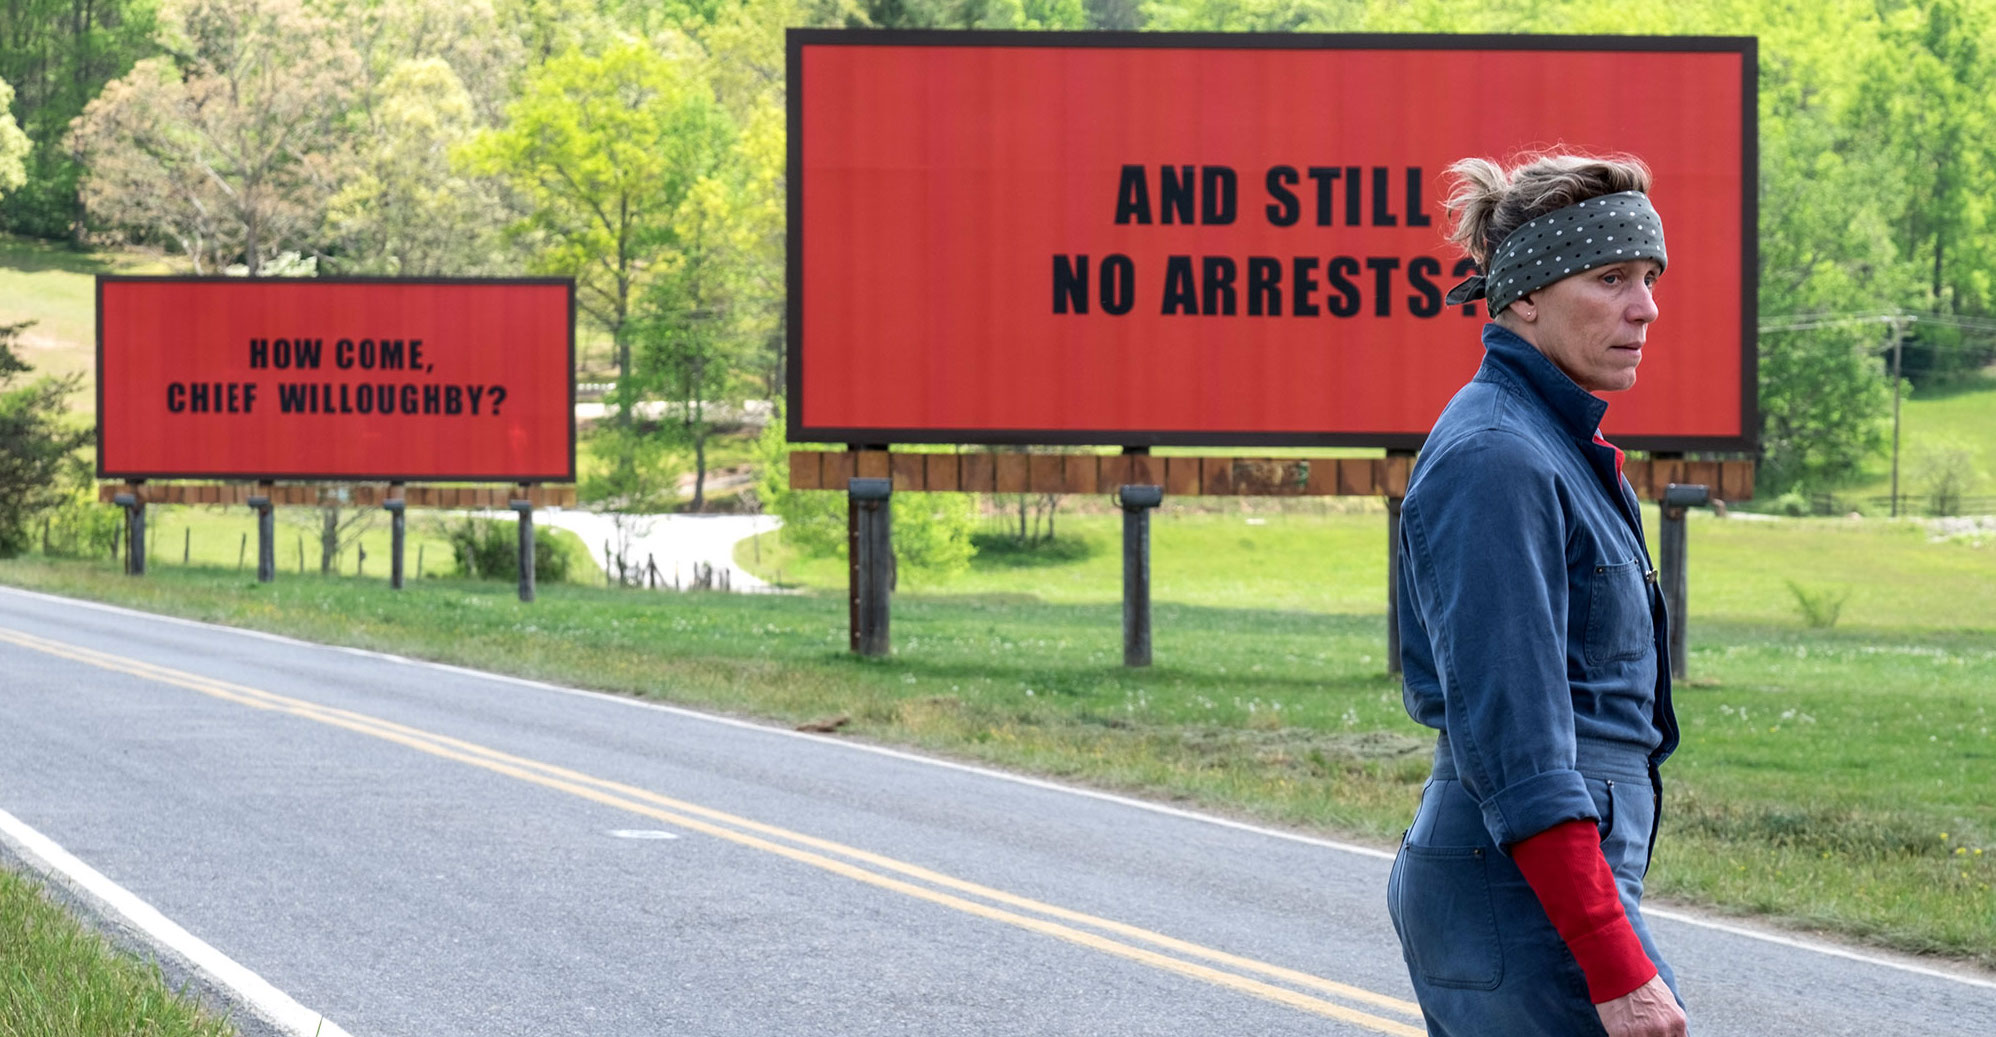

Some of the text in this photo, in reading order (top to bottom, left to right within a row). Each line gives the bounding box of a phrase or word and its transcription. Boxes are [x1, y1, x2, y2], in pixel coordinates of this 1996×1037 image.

[1114, 164, 1431, 228] AND STILL
[1052, 253, 1135, 316] NO
[249, 338, 435, 374] HOW COME,
[167, 382, 507, 416] CHIEF WILLOUGHBY?
